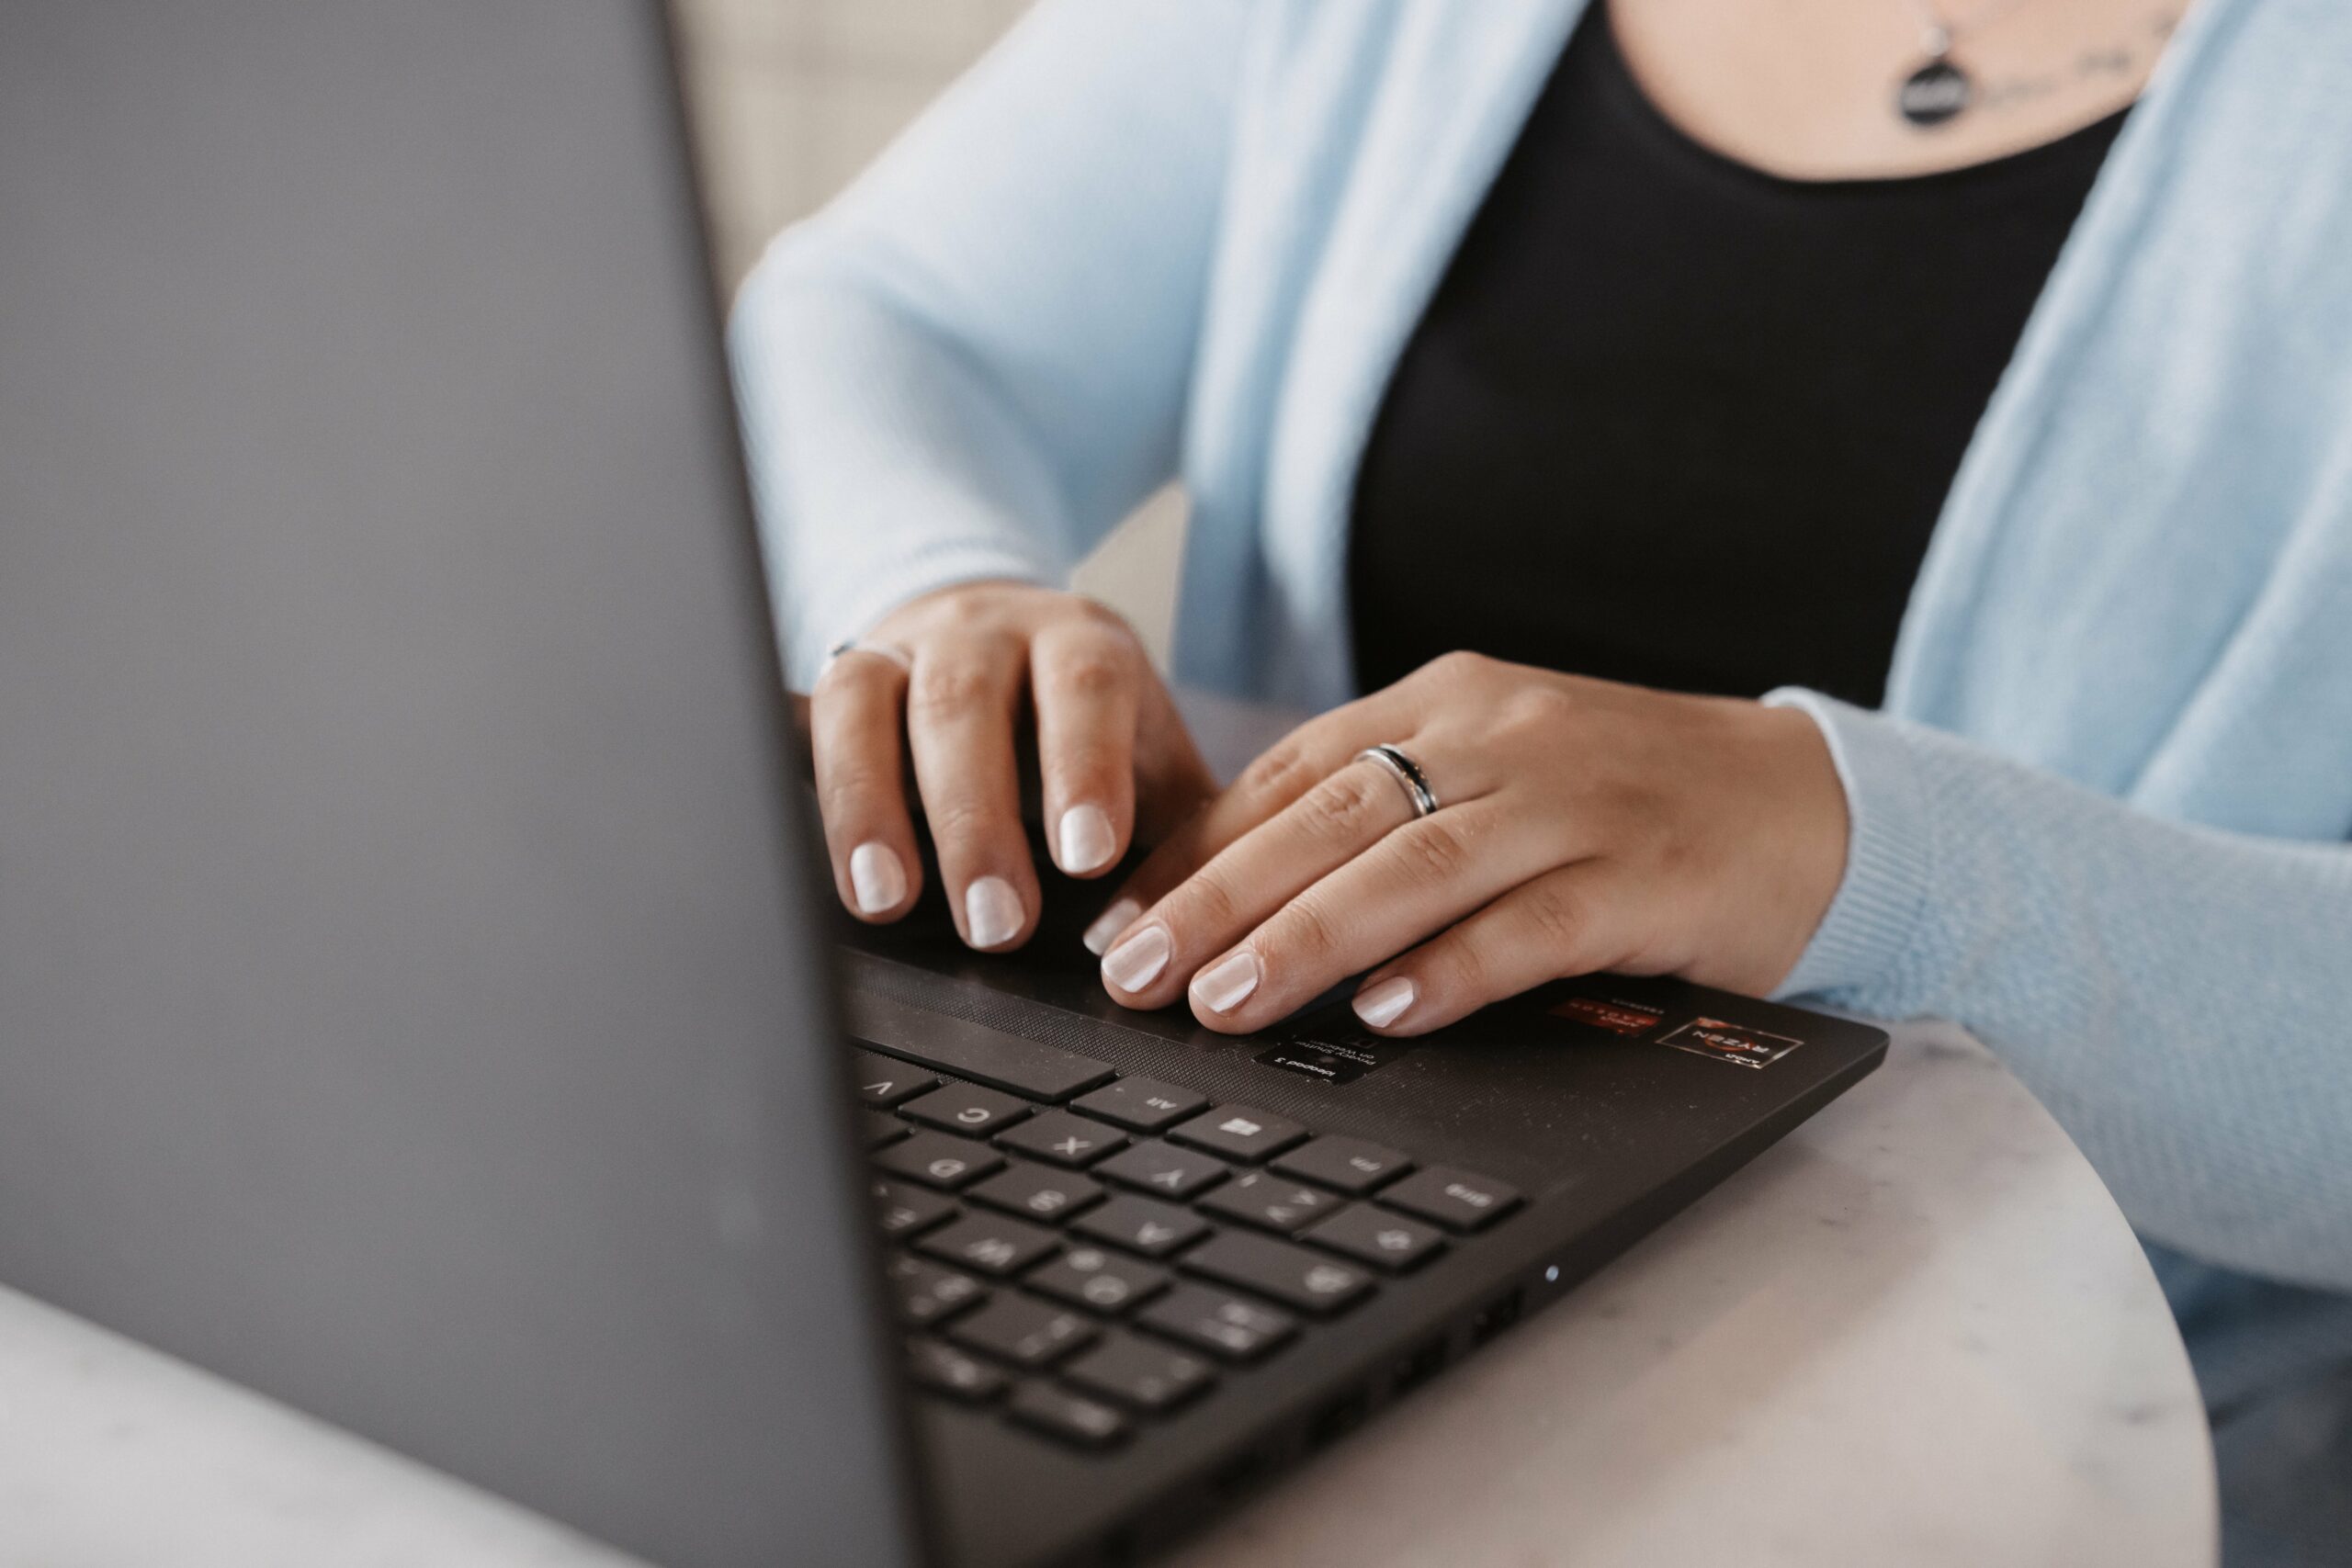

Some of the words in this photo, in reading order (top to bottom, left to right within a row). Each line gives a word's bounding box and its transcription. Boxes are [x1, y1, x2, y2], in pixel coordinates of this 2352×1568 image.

[1294, 1041, 1333, 1055] Shutter
[1309, 1040, 1356, 1055] Webcam
[1691, 1030, 1770, 1054] RYZEN
[1334, 1051, 1376, 1066] Privacy
[862, 1081, 894, 1095] V
[1146, 1098, 1177, 1111] Alt
[957, 1108, 990, 1122] C
[1053, 1136, 1092, 1155] X
[928, 1158, 966, 1179] D
[1150, 1169, 1185, 1187] Y
